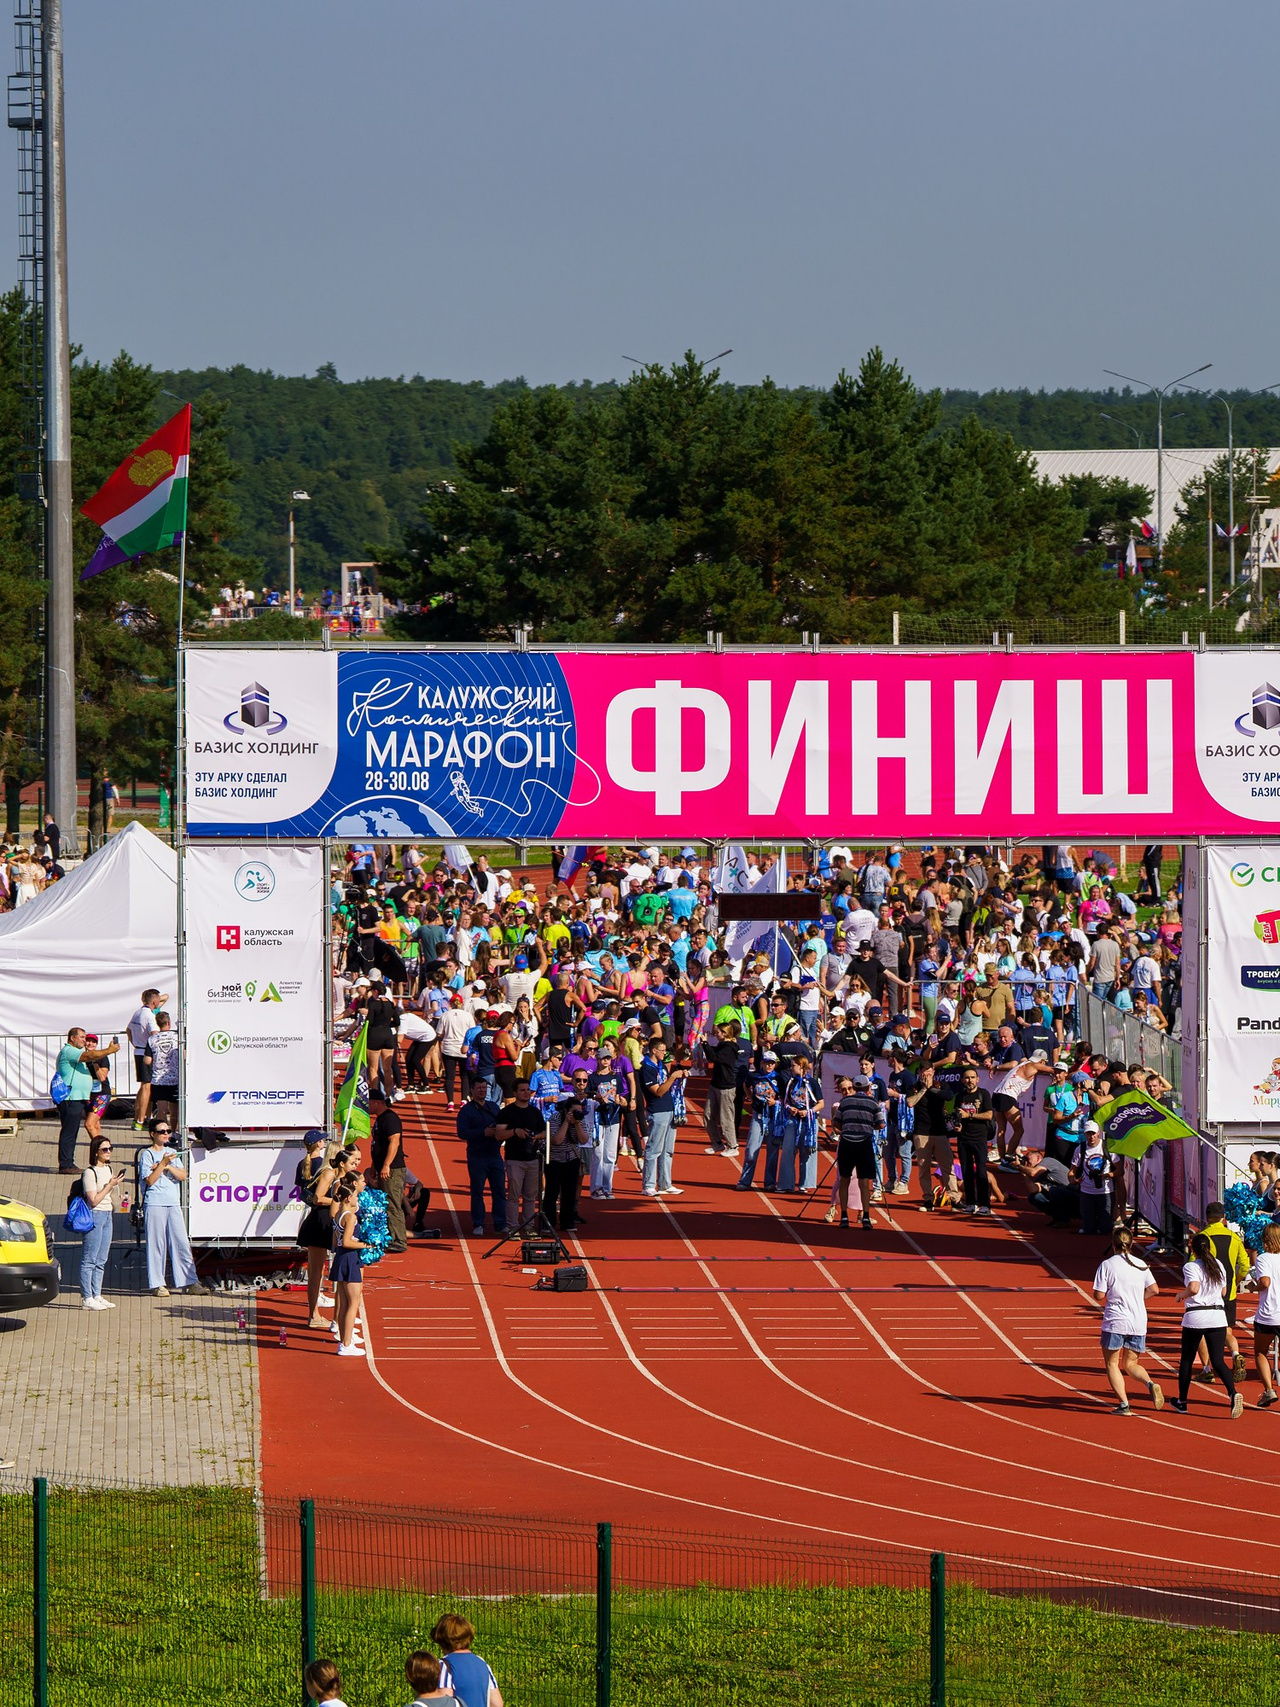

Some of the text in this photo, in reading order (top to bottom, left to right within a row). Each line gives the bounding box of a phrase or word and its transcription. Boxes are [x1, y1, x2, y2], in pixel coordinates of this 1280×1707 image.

[418, 683, 556, 709] КАЛУЖСКИЙ
[347, 678, 572, 737] Космический
[194, 742, 319, 756] БАЗИС ХОЛДИНГ
[366, 730, 555, 769] МАРАФОН
[605, 679, 1174, 815] ФИНИШ
[1205, 745, 1255, 757] БАЗИС
[195, 772, 287, 784] ЭТУ АРКУ СДЕЛАЛ
[365, 771, 430, 791] 28-30.08
[1242, 772, 1261, 782] ЭТУ
[195, 787, 278, 800] БАЗИС ХОЛДИНГ
[244, 929, 294, 938] калужская
[244, 938, 283, 946] область
[207, 989, 242, 998] бизнес
[221, 983, 242, 992] мой
[229, 1091, 304, 1099] TRANSOFF
[199, 1172, 230, 1183] PRO
[199, 1185, 302, 1203] СПОРТ 4
[252, 1204, 274, 1212] БУДЬ
